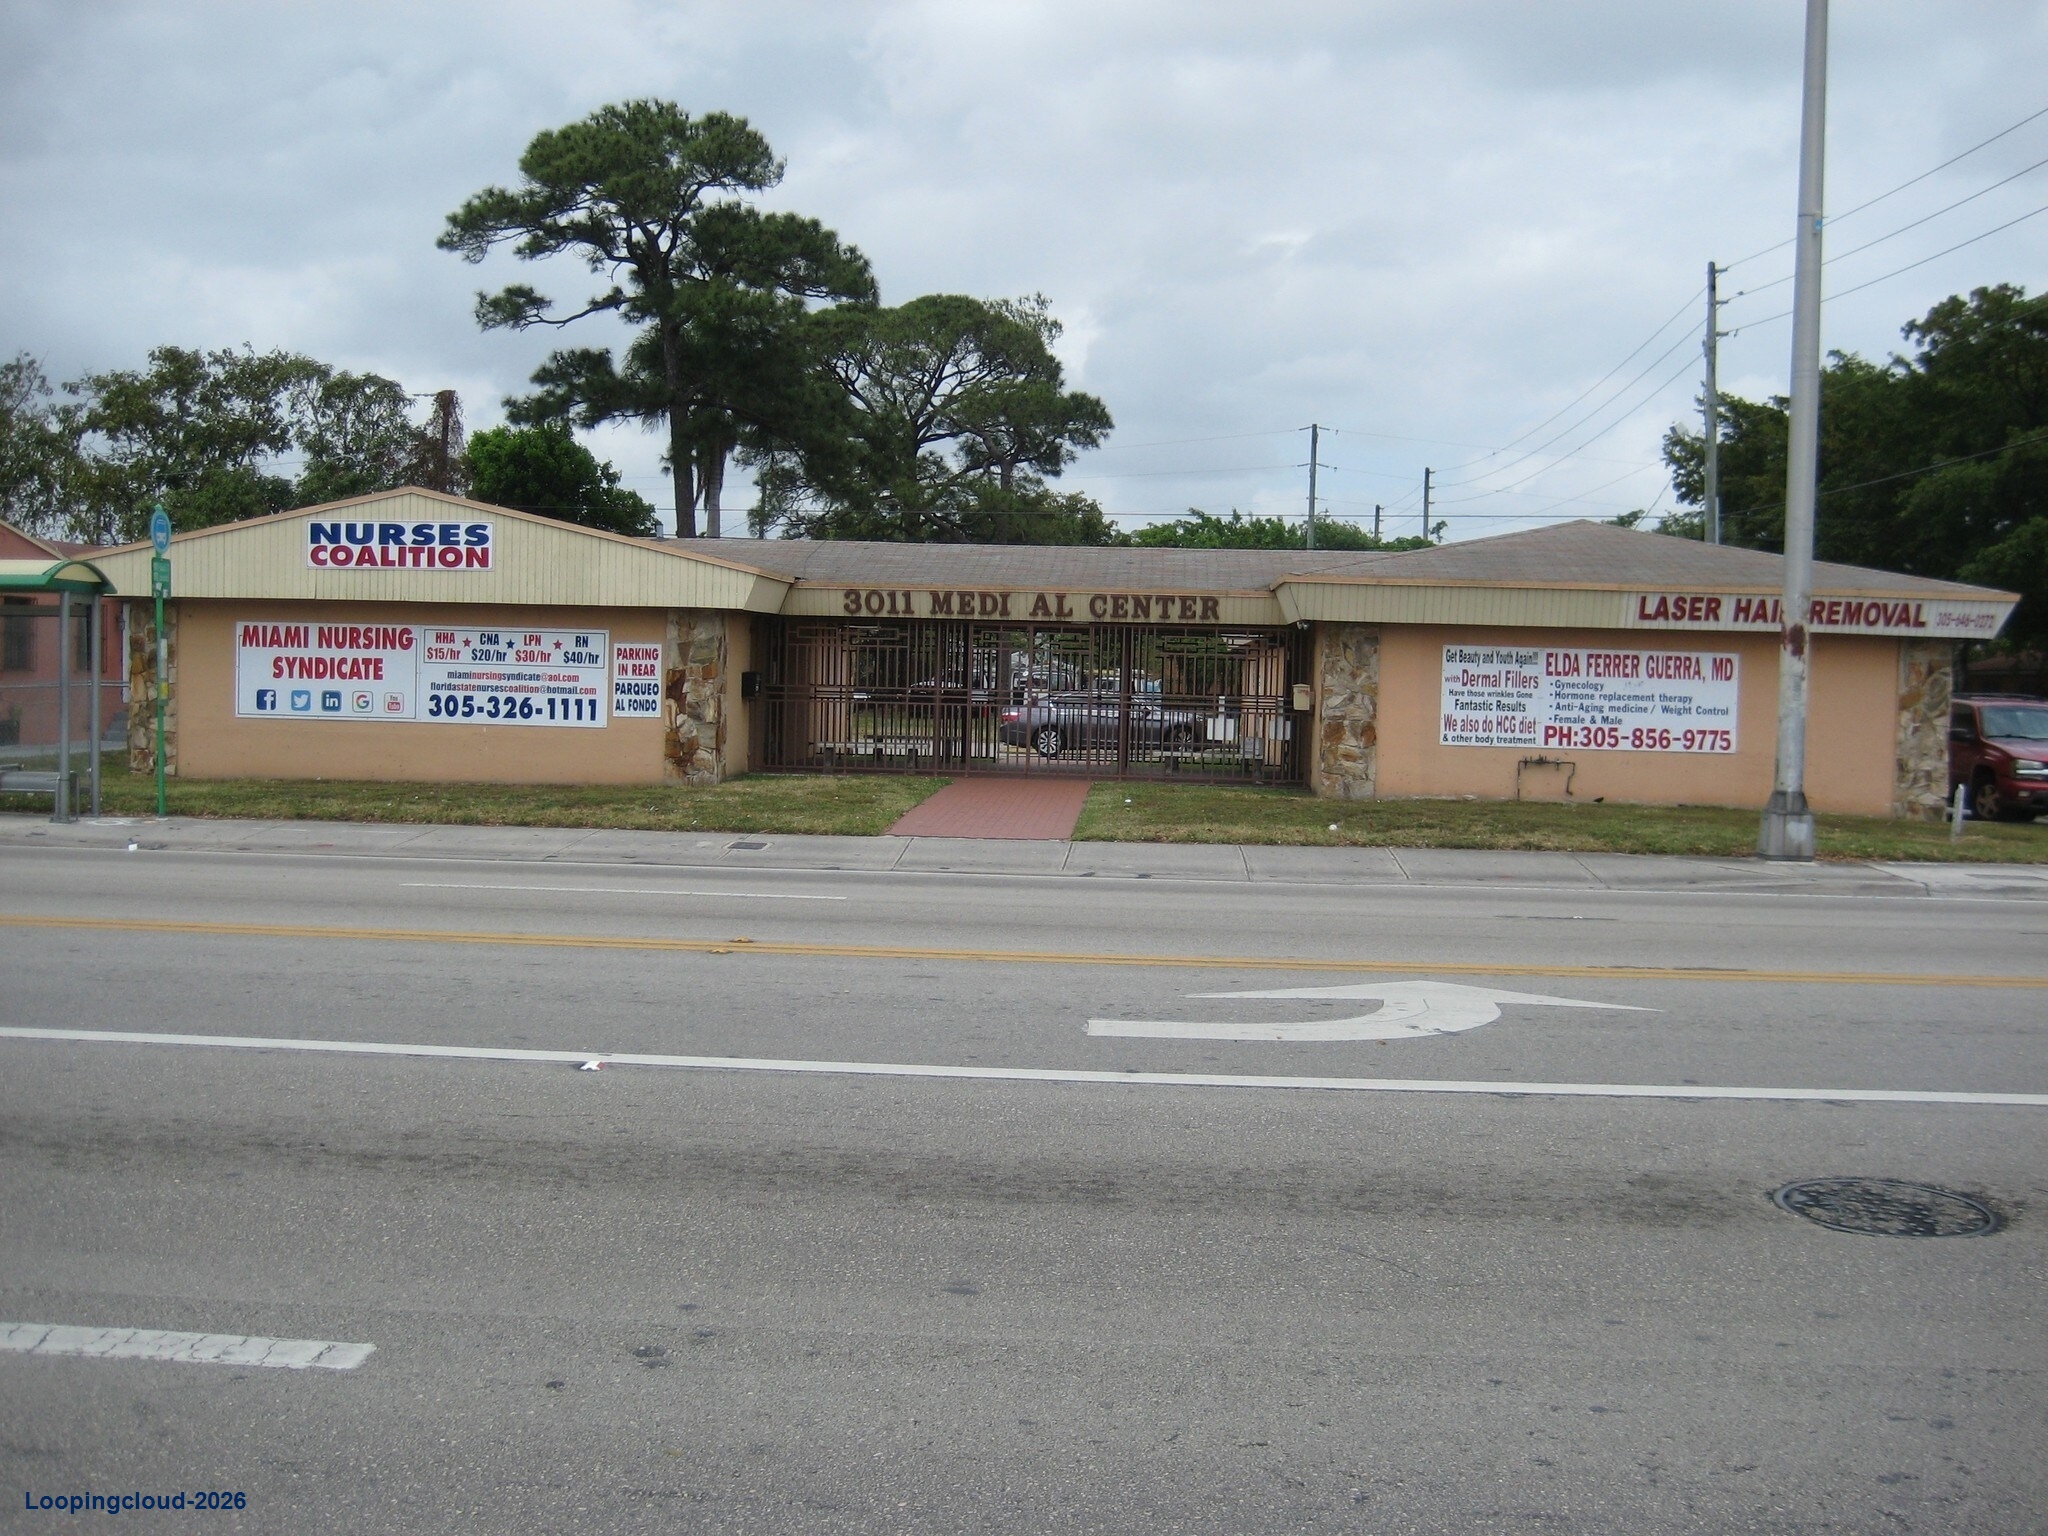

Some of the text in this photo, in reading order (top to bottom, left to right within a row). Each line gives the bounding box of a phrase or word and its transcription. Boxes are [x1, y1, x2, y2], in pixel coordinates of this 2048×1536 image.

[310, 523, 490, 546] NURSES
[310, 545, 489, 567] COALITION
[843, 589, 915, 615] 3011
[1089, 595, 1220, 620] CENTER
[1638, 596, 1926, 627] LASER HAI REMOVAL
[242, 625, 414, 650] MIAMI NURSING
[435, 632, 589, 648] HHA CNA LPN RN
[427, 648, 600, 665] $15/hr $20/hr $30/hr $40/hr
[616, 648, 659, 661] PARKING
[1446, 649, 1457, 663] Get
[1459, 649, 1481, 667] Beauty
[1482, 651, 1493, 664] and
[1496, 651, 1513, 665] Youth
[272, 656, 384, 680] SYNDICATE
[618, 663, 656, 677] IN REAR
[1545, 652, 1733, 683] ELDA FERRER GUERRA, MD
[447, 671, 580, 683] miaminursingsyndicate@aol.com
[1445, 669, 1539, 689] with Dermal Fillers
[430, 682, 597, 696] floridastatenursescoalition@hotmail.com
[615, 683, 659, 696] PARQUEO
[1554, 680, 1604, 691] Gynecology
[1448, 689, 1533, 699] Have those wrinkles Gone
[1554, 691, 1693, 704] Hormone replacement therapy
[428, 694, 597, 721] 305-326-1111
[615, 698, 657, 712] AL FONDO
[1455, 699, 1526, 712] Fantastic Results
[1555, 703, 1604, 714] Anti-Aging
[1608, 704, 1648, 713] medicine
[1661, 705, 1692, 715] Weight
[1695, 706, 1729, 715] Control
[1444, 713, 1536, 734] We also do HCG diet
[1553, 715, 1623, 725] Female & Male
[1443, 734, 1536, 745] & other body treatment
[1543, 725, 1731, 751] PH:305-856-9775
